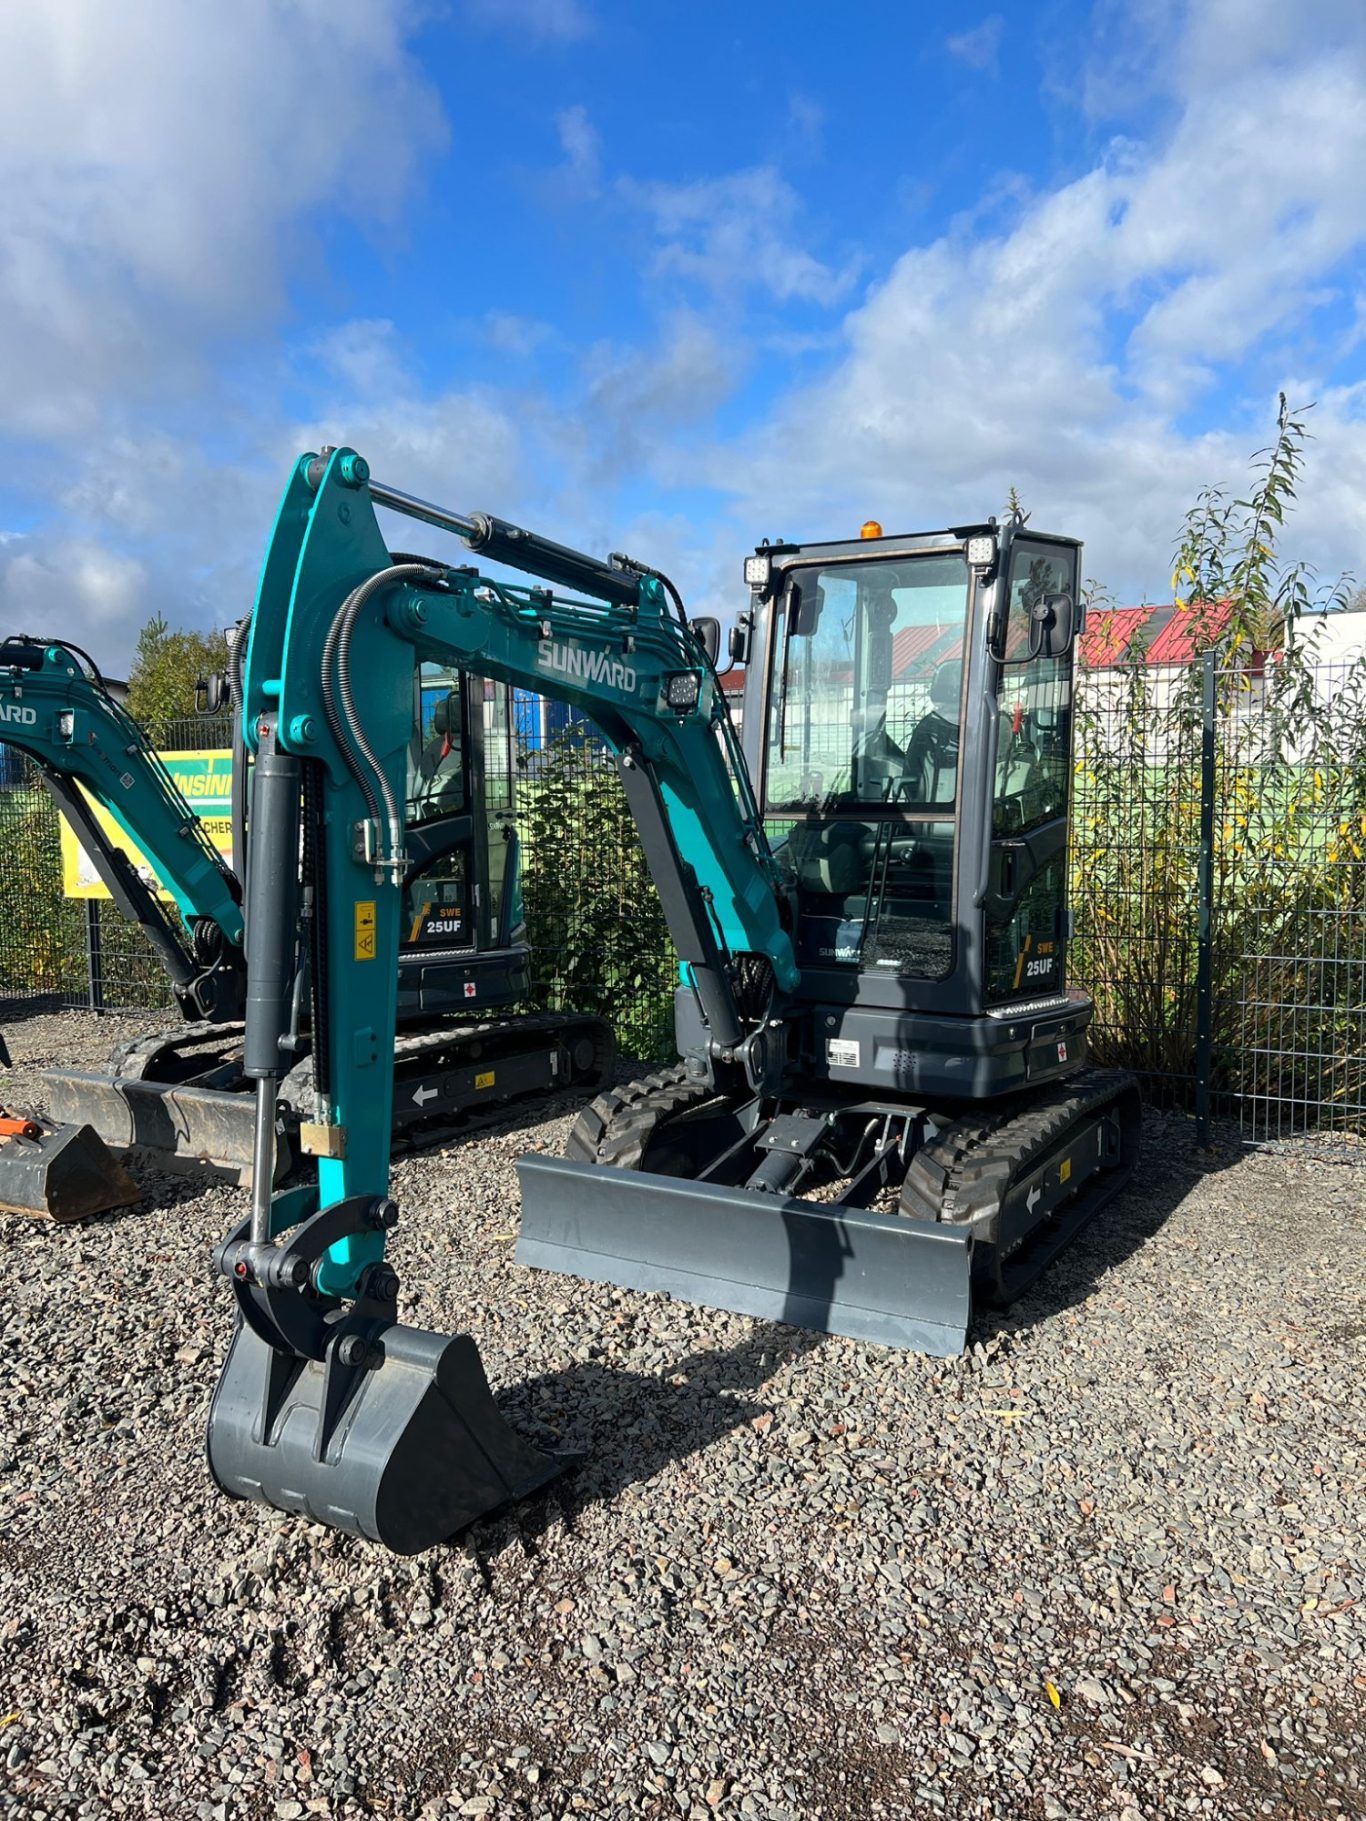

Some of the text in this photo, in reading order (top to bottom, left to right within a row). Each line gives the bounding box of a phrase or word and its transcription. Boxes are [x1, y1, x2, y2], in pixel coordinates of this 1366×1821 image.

[538, 640, 636, 693] SUNWARD
[197, 821, 232, 833] CHER
[440, 908, 461, 917] SWE
[427, 920, 461, 933] 25UF
[1037, 941, 1054, 954] SWE
[1027, 958, 1053, 977] 25UF
